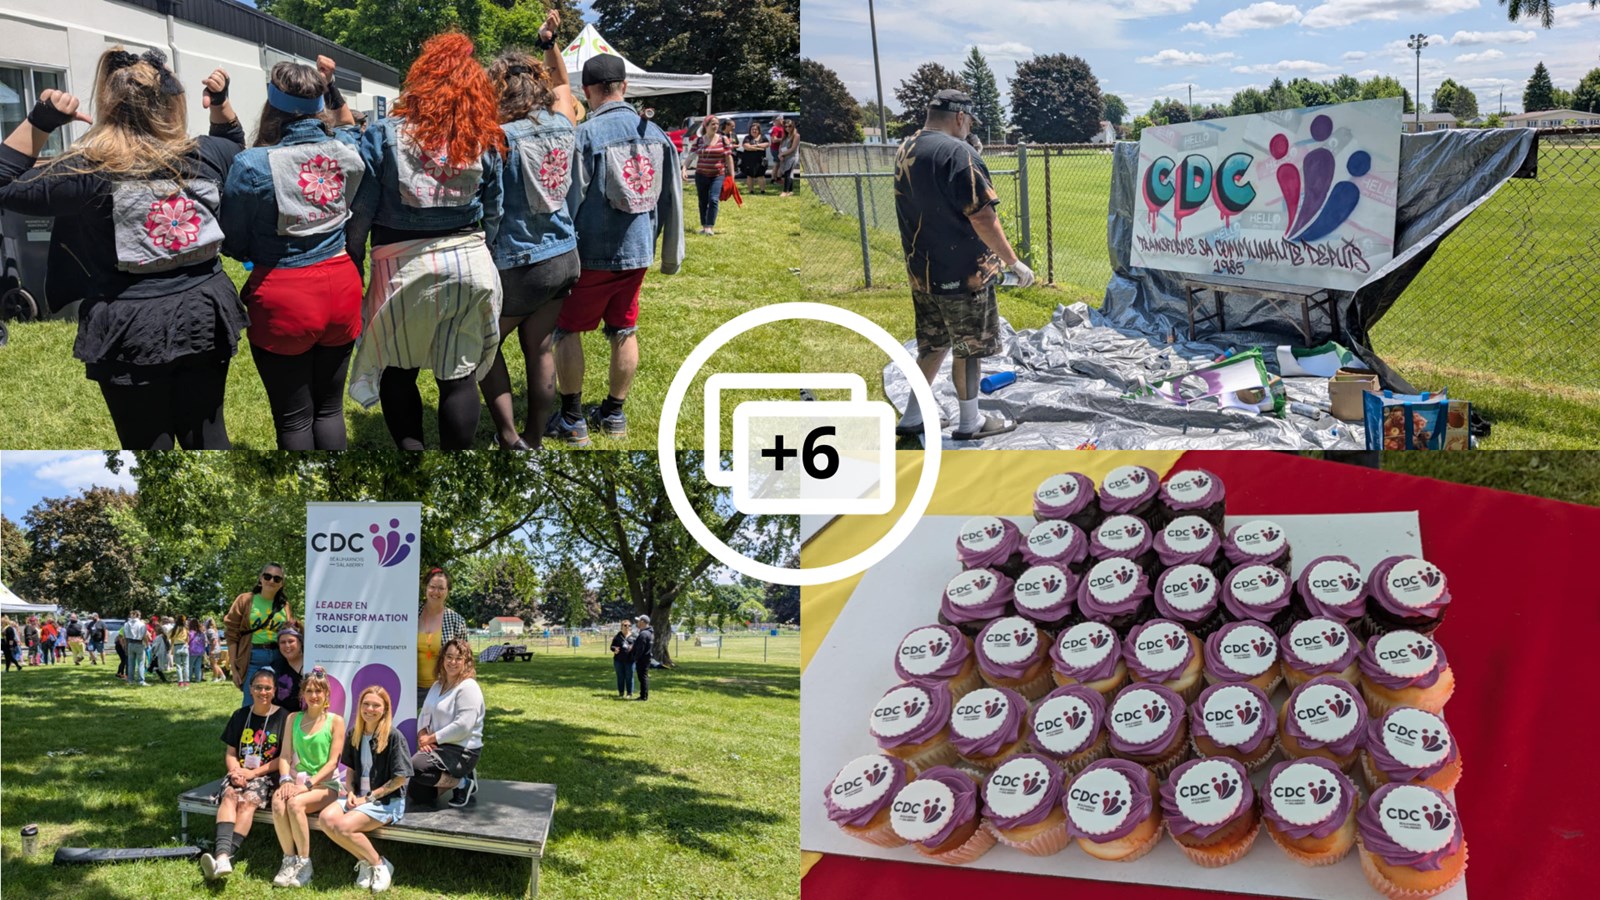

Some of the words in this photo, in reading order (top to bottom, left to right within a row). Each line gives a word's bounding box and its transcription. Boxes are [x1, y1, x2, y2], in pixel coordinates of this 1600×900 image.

[1142, 152, 1256, 222] CDC
[1249, 212, 1281, 224] HELLO
[1136, 235, 1197, 257] TRANSFORME
[1198, 237, 1214, 258] SA
[1300, 235, 1371, 274] DEPUIS
[1213, 260, 1245, 275] 1985
[1108, 478, 1129, 490] CDC
[1170, 480, 1191, 491] CDC
[1038, 487, 1058, 499] CDC
[962, 530, 982, 542] CDC
[1029, 532, 1052, 544] CDC
[1100, 528, 1122, 538] CDC
[1167, 529, 1190, 537] CDC
[1237, 533, 1260, 542] CDC
[311, 532, 364, 553] CDC
[1016, 582, 1040, 592] CDC
[1090, 575, 1113, 588] CDC
[1233, 578, 1258, 590] CDC
[1312, 579, 1338, 588] CDC
[1392, 576, 1419, 588] CDC
[948, 584, 972, 596] CDC
[1164, 582, 1188, 594] CDC
[315, 600, 353, 610] LEADER
[355, 602, 368, 610] EN
[316, 612, 408, 622] TRANSFORMATION
[315, 624, 358, 634] SOCIALE
[986, 633, 1011, 642] CDC
[1294, 636, 1321, 647] CDC
[902, 645, 926, 655] CDC
[1062, 638, 1087, 650] CDC
[1138, 639, 1163, 651] CDC
[1223, 643, 1250, 654] CDC
[1379, 649, 1408, 661] CDC
[874, 706, 900, 717] CDC
[956, 705, 982, 715] CDC
[1205, 710, 1233, 722] CDC
[1297, 705, 1327, 720] CDC
[1114, 710, 1142, 723] CDC
[1035, 717, 1063, 733] CDC
[1387, 722, 1418, 740] CDC
[834, 776, 862, 795] CDC
[992, 775, 1021, 787] CDC
[1070, 789, 1100, 804] CDC
[1180, 783, 1210, 798] CDC
[1274, 786, 1305, 797] CDC
[893, 801, 921, 814] CDC
[1386, 808, 1420, 822] CDC
